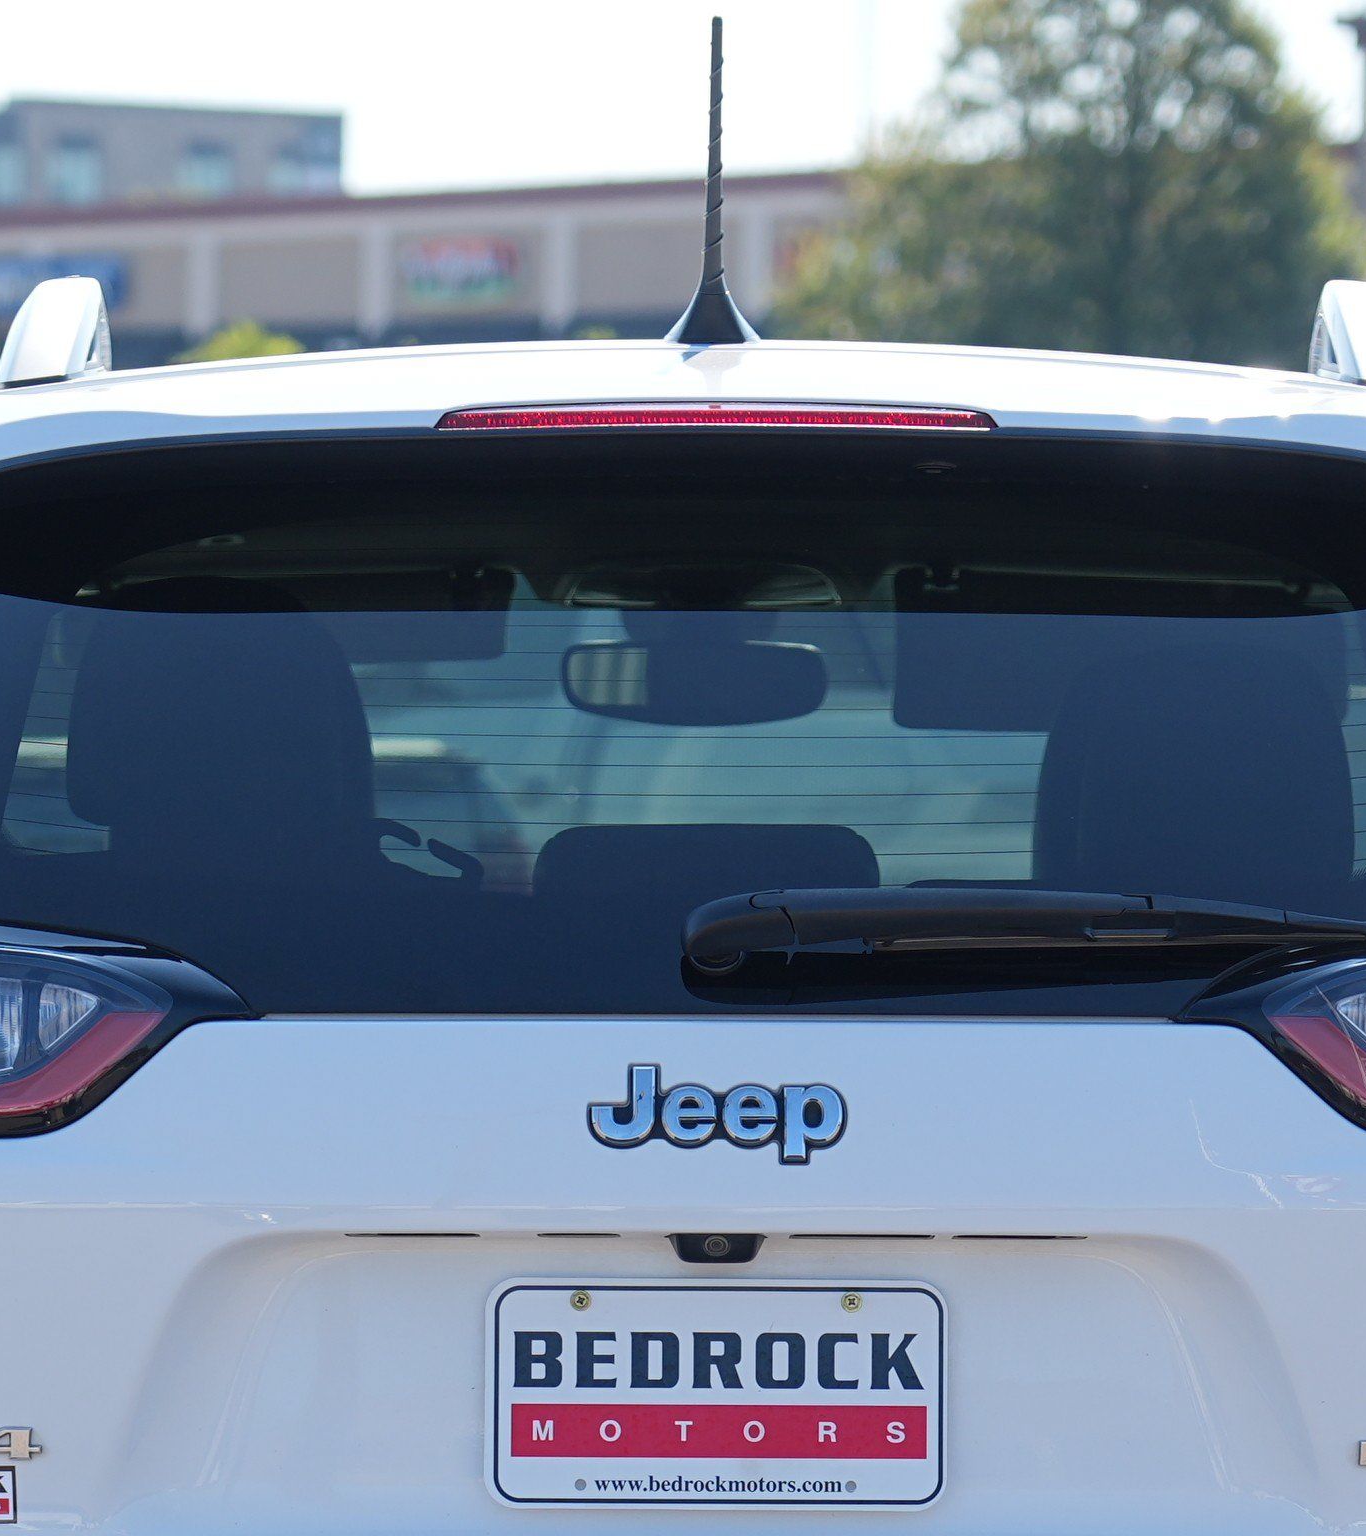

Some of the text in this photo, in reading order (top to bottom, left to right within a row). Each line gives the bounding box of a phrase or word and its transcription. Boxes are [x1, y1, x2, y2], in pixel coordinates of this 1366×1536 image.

[588, 1064, 847, 1165] Jeep
[513, 1331, 925, 1390] BEDROCK
[531, 1420, 906, 1443] MOTORS
[594, 1474, 843, 1494] www.bedrockmotors.com
